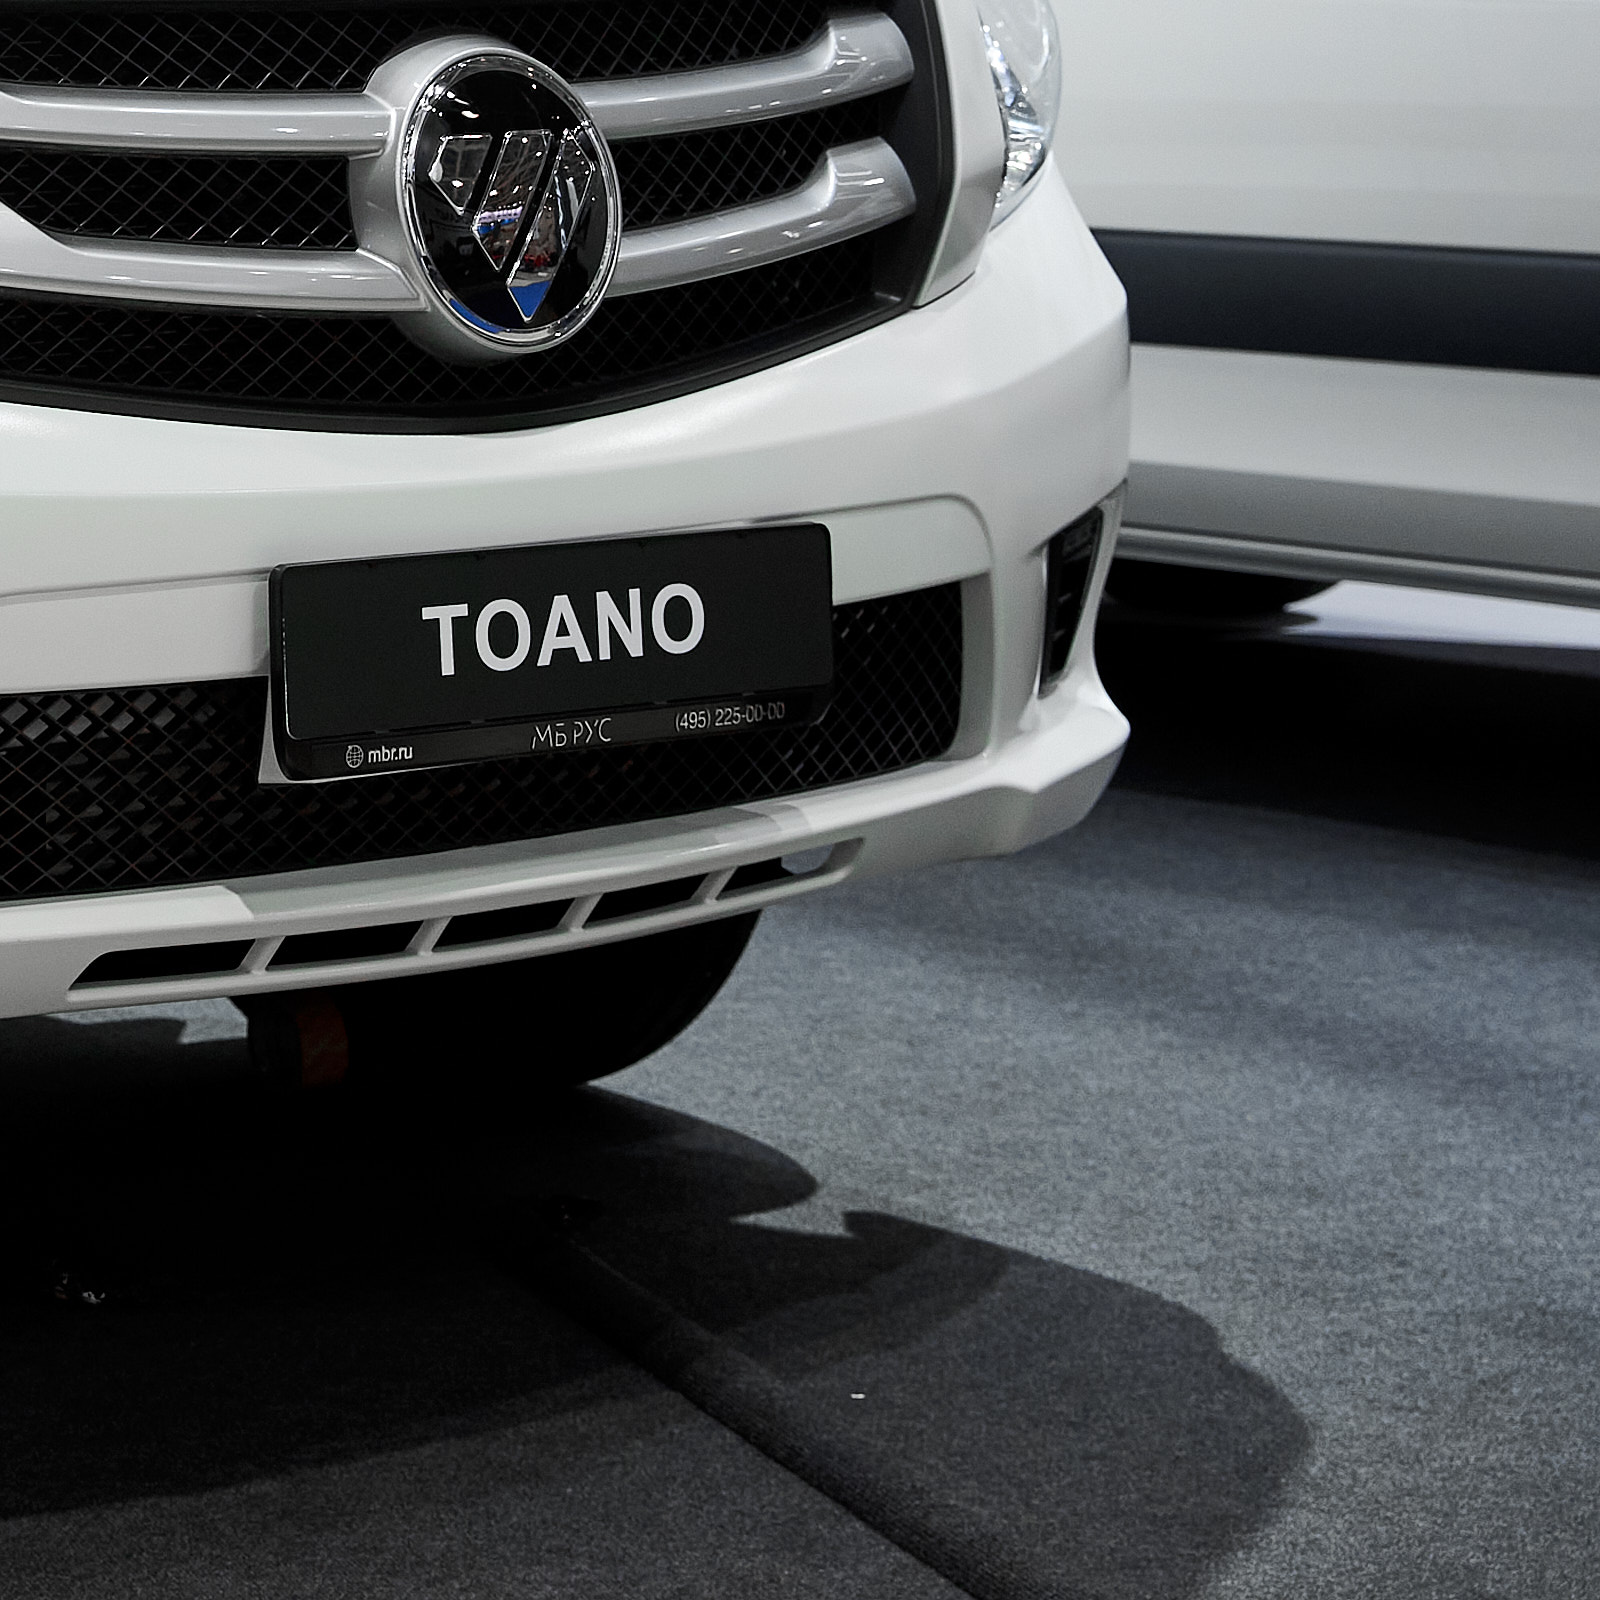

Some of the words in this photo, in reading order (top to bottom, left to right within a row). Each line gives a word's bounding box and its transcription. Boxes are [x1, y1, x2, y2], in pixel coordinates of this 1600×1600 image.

[421, 582, 706, 677] TOANO
[674, 710, 713, 732] (495)
[368, 744, 414, 764] mbr.ru
